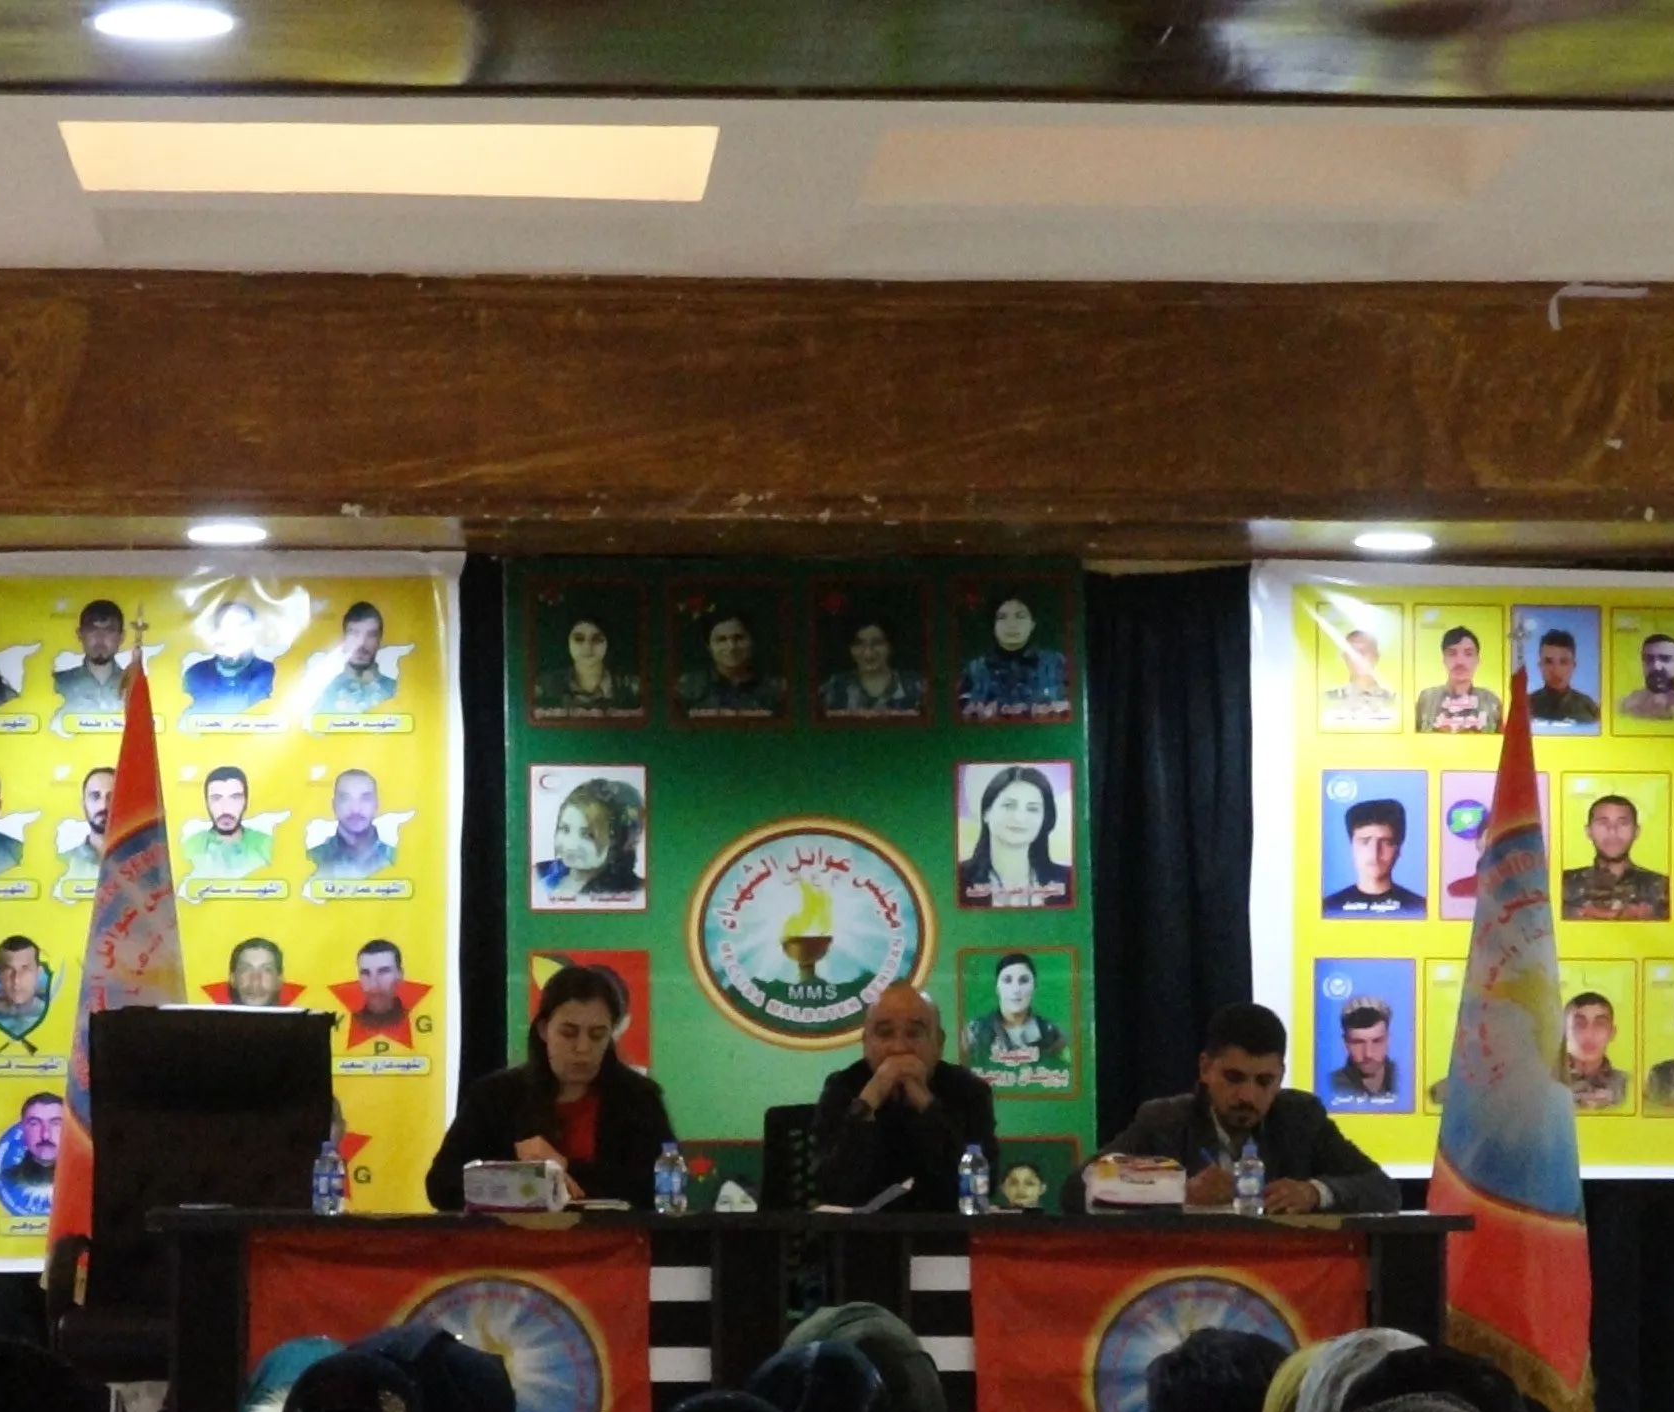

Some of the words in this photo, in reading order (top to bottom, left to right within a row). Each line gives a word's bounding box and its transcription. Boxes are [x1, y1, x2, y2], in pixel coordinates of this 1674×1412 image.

[786, 846, 852, 874] عوائل
[788, 983, 838, 1001] MMS
[415, 1015, 433, 1033] G
